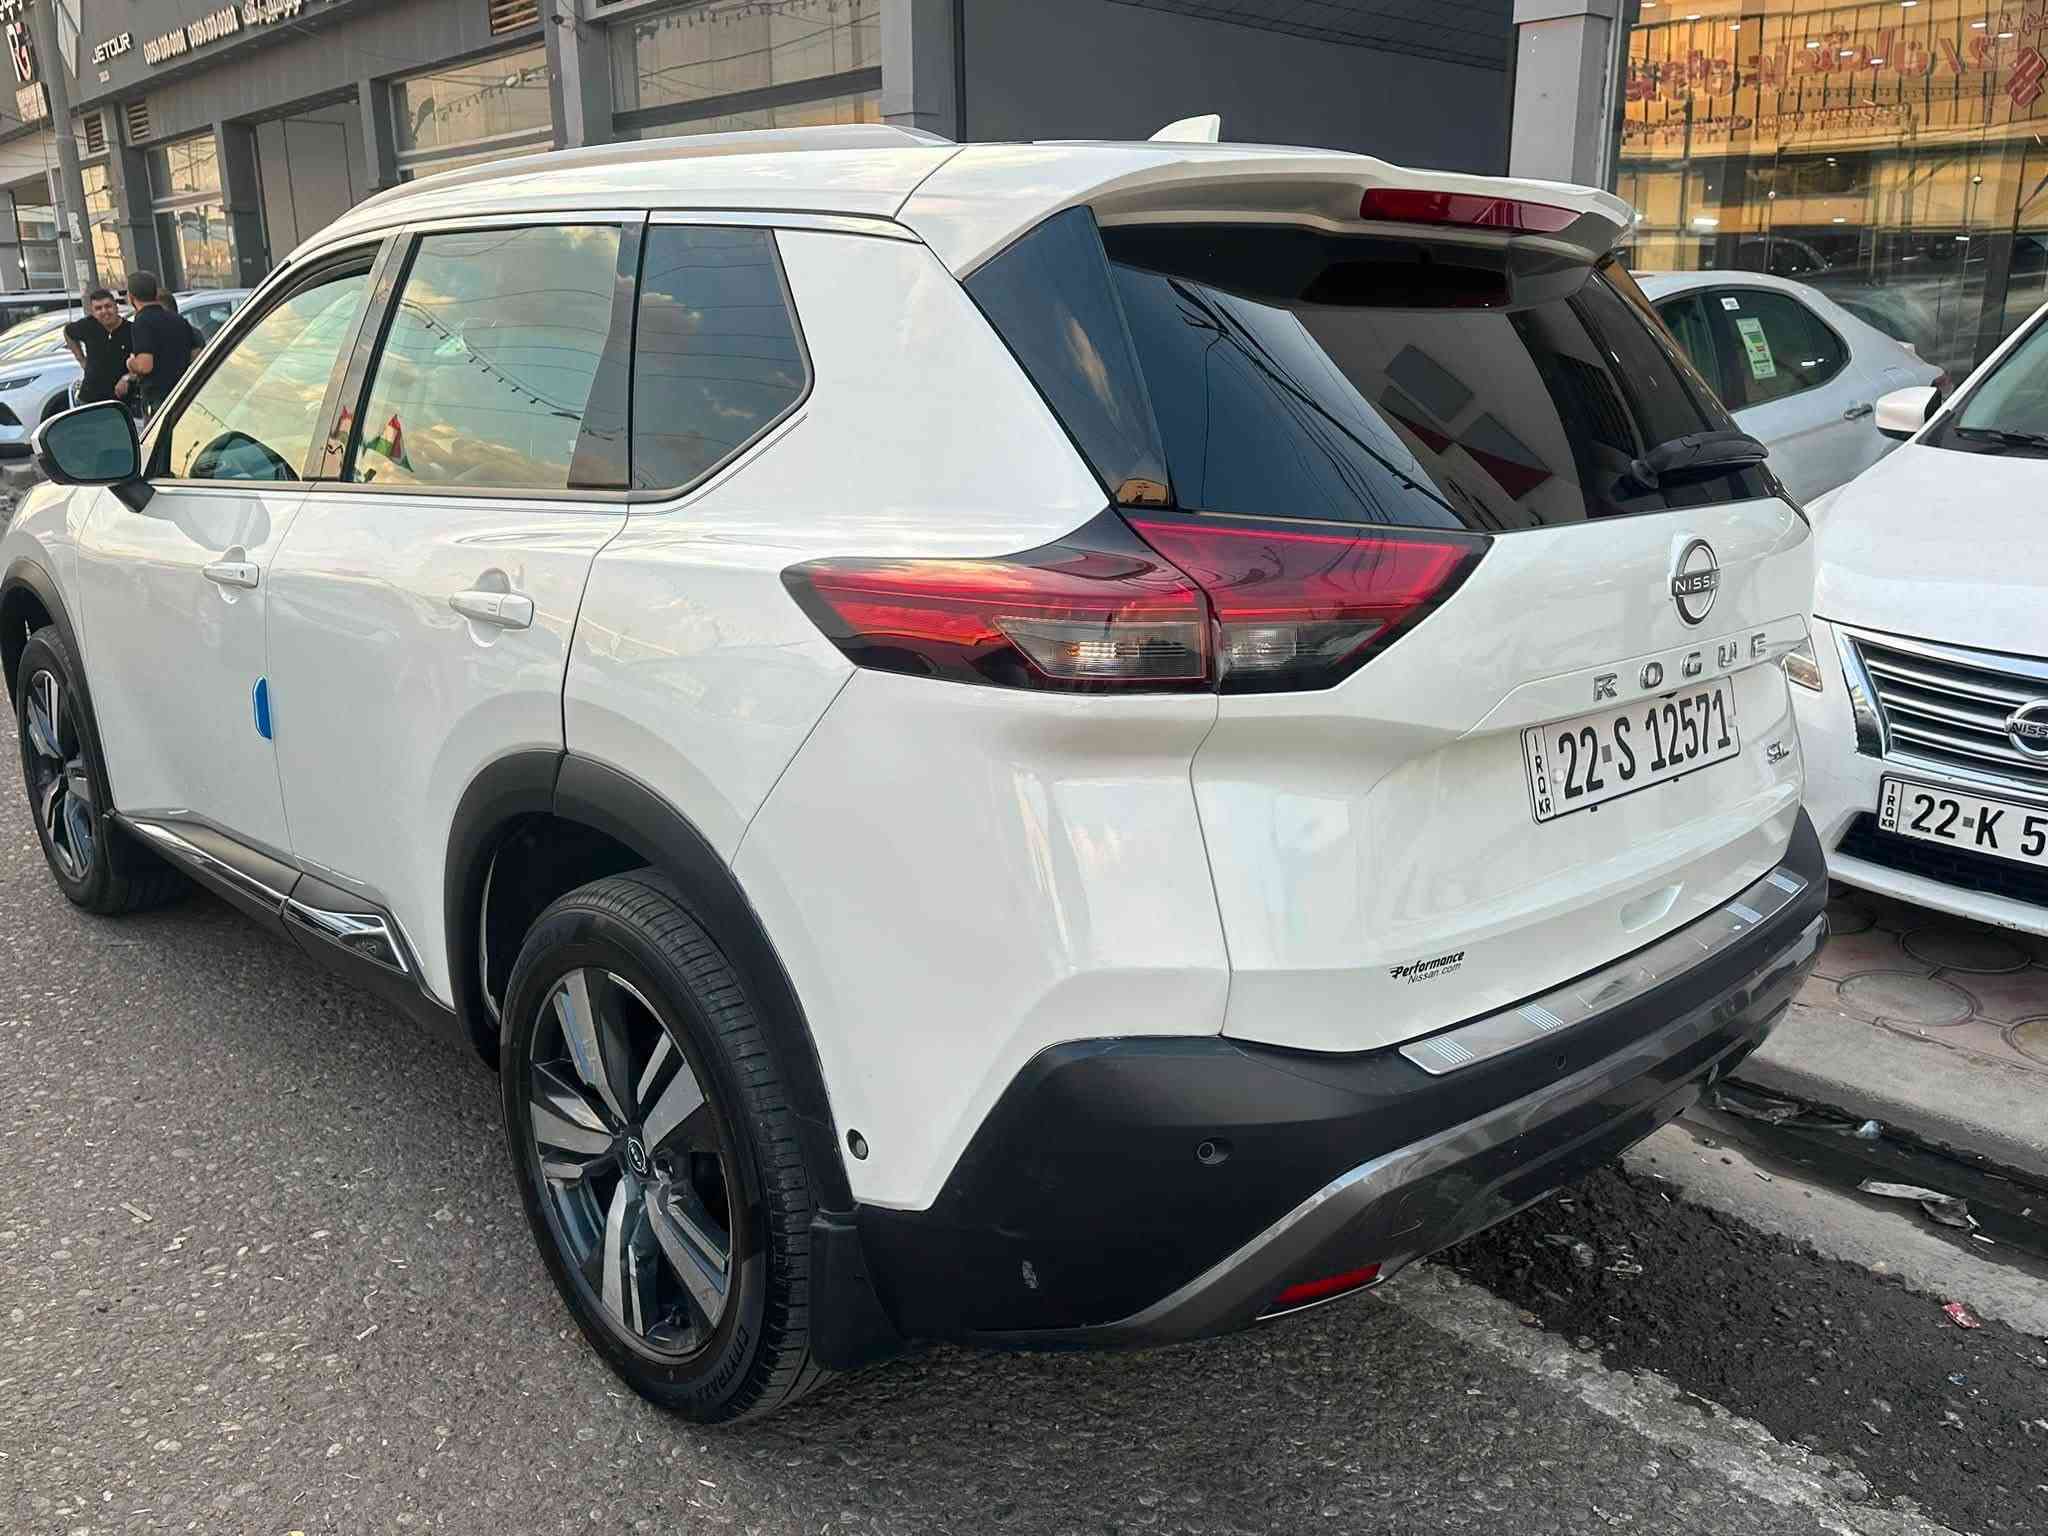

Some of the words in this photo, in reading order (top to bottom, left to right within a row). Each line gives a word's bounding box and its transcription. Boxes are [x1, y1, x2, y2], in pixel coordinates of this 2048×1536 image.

[91, 32, 131, 64] JETOUR
[1675, 573, 1719, 592] NISS
[1593, 633, 1766, 701] ROGUE
[1645, 689, 1731, 771] 12571
[1766, 740, 1789, 765] SL
[1539, 797, 1552, 814] KR
[1881, 818, 1895, 829] KR
[1390, 951, 1464, 979] Performance
